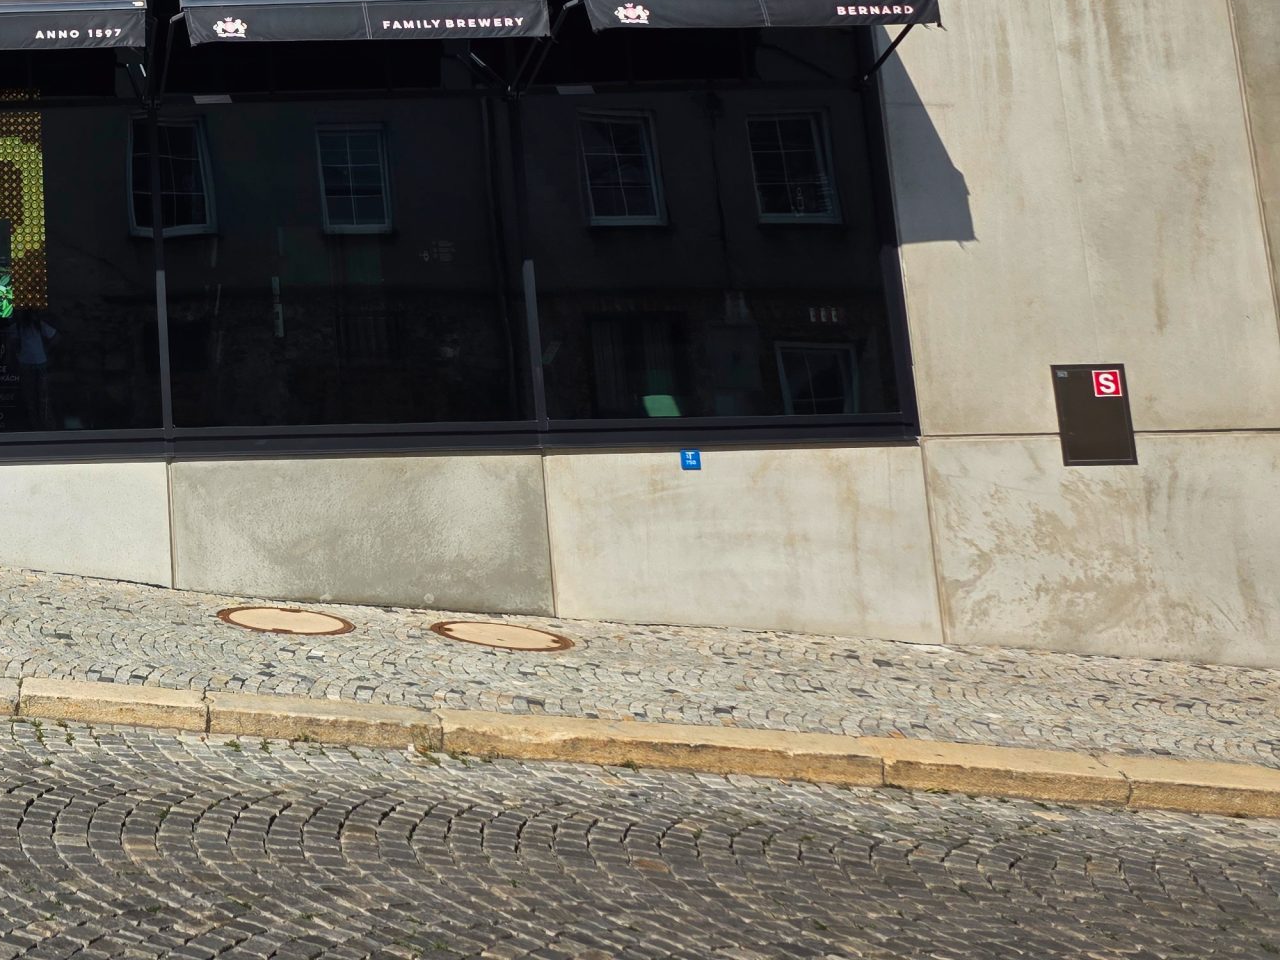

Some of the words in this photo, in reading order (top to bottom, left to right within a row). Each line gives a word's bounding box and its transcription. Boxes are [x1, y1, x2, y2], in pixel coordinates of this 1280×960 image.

[836, 5, 914, 16] BERNARD
[382, 19, 441, 30] FAMILY
[445, 17, 524, 29] BREWERY
[35, 30, 79, 39] ANNO
[87, 28, 122, 38] 1597
[1098, 373, 1116, 394] S
